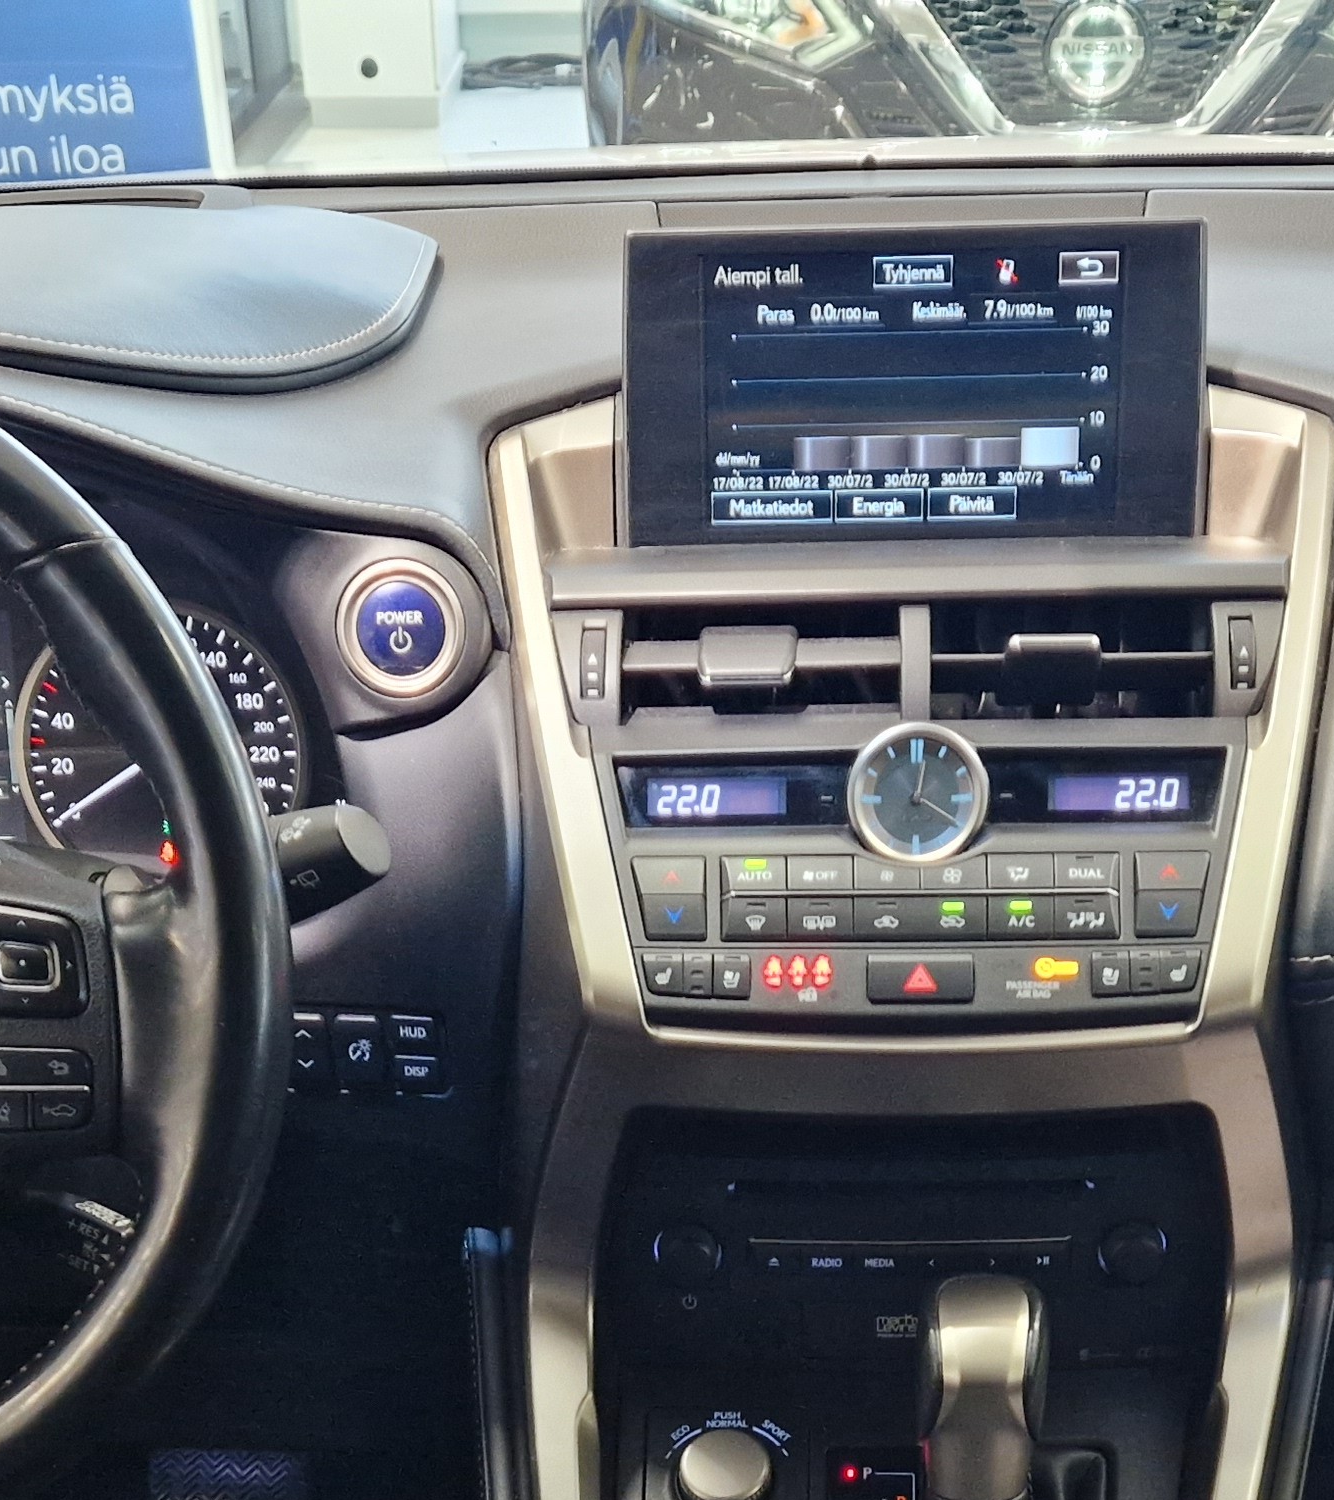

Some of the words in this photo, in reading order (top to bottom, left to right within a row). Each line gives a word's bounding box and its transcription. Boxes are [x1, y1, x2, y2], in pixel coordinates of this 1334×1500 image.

[1061, 42, 1134, 56] NISSAN
[49, 135, 125, 174] iloa
[714, 265, 771, 289] Aiempi
[774, 264, 803, 285] tall.
[882, 264, 945, 284] Tyhjennä
[757, 304, 795, 324] Paras
[862, 307, 879, 321] km
[1037, 303, 1054, 317] km
[1092, 320, 1110, 336] 30
[1090, 365, 1108, 382] 20
[1089, 411, 1105, 427] 10
[1090, 455, 1101, 471] 0
[713, 477, 764, 490] 17/08/22
[768, 476, 819, 490] 17/08/22
[828, 474, 874, 488] 30/07/2
[884, 473, 930, 487] 30/07/2
[941, 472, 987, 486] 30/07/2
[998, 471, 1044, 486] 30/07/2
[729, 498, 814, 518] Matkatiedot
[853, 497, 906, 518] Energia
[949, 494, 995, 514] Päivitä
[375, 610, 424, 625] POWER
[228, 672, 247, 684] 160
[235, 692, 264, 710] 180
[51, 712, 75, 730] 40
[253, 721, 274, 733] 200
[249, 746, 280, 763] 220
[51, 757, 75, 776] 20
[256, 776, 276, 789] 240
[657, 784, 721, 816] 22.0
[1115, 778, 1180, 809] 22.0
[737, 870, 772, 881] AUTO
[815, 870, 838, 881] OFF
[1068, 867, 1105, 879] DUAL
[1008, 915, 1035, 928] A/C
[399, 1026, 427, 1039] HUD
[404, 1065, 429, 1077] DISP
[811, 1257, 843, 1268] RADIO
[864, 1258, 895, 1268] MEDIA
[706, 1419, 749, 1428] NORMAL
[713, 1411, 741, 1420] PUSH
[670, 1424, 690, 1441] ECO
[761, 1419, 792, 1442] SPORT
[862, 1466, 873, 1480] P
